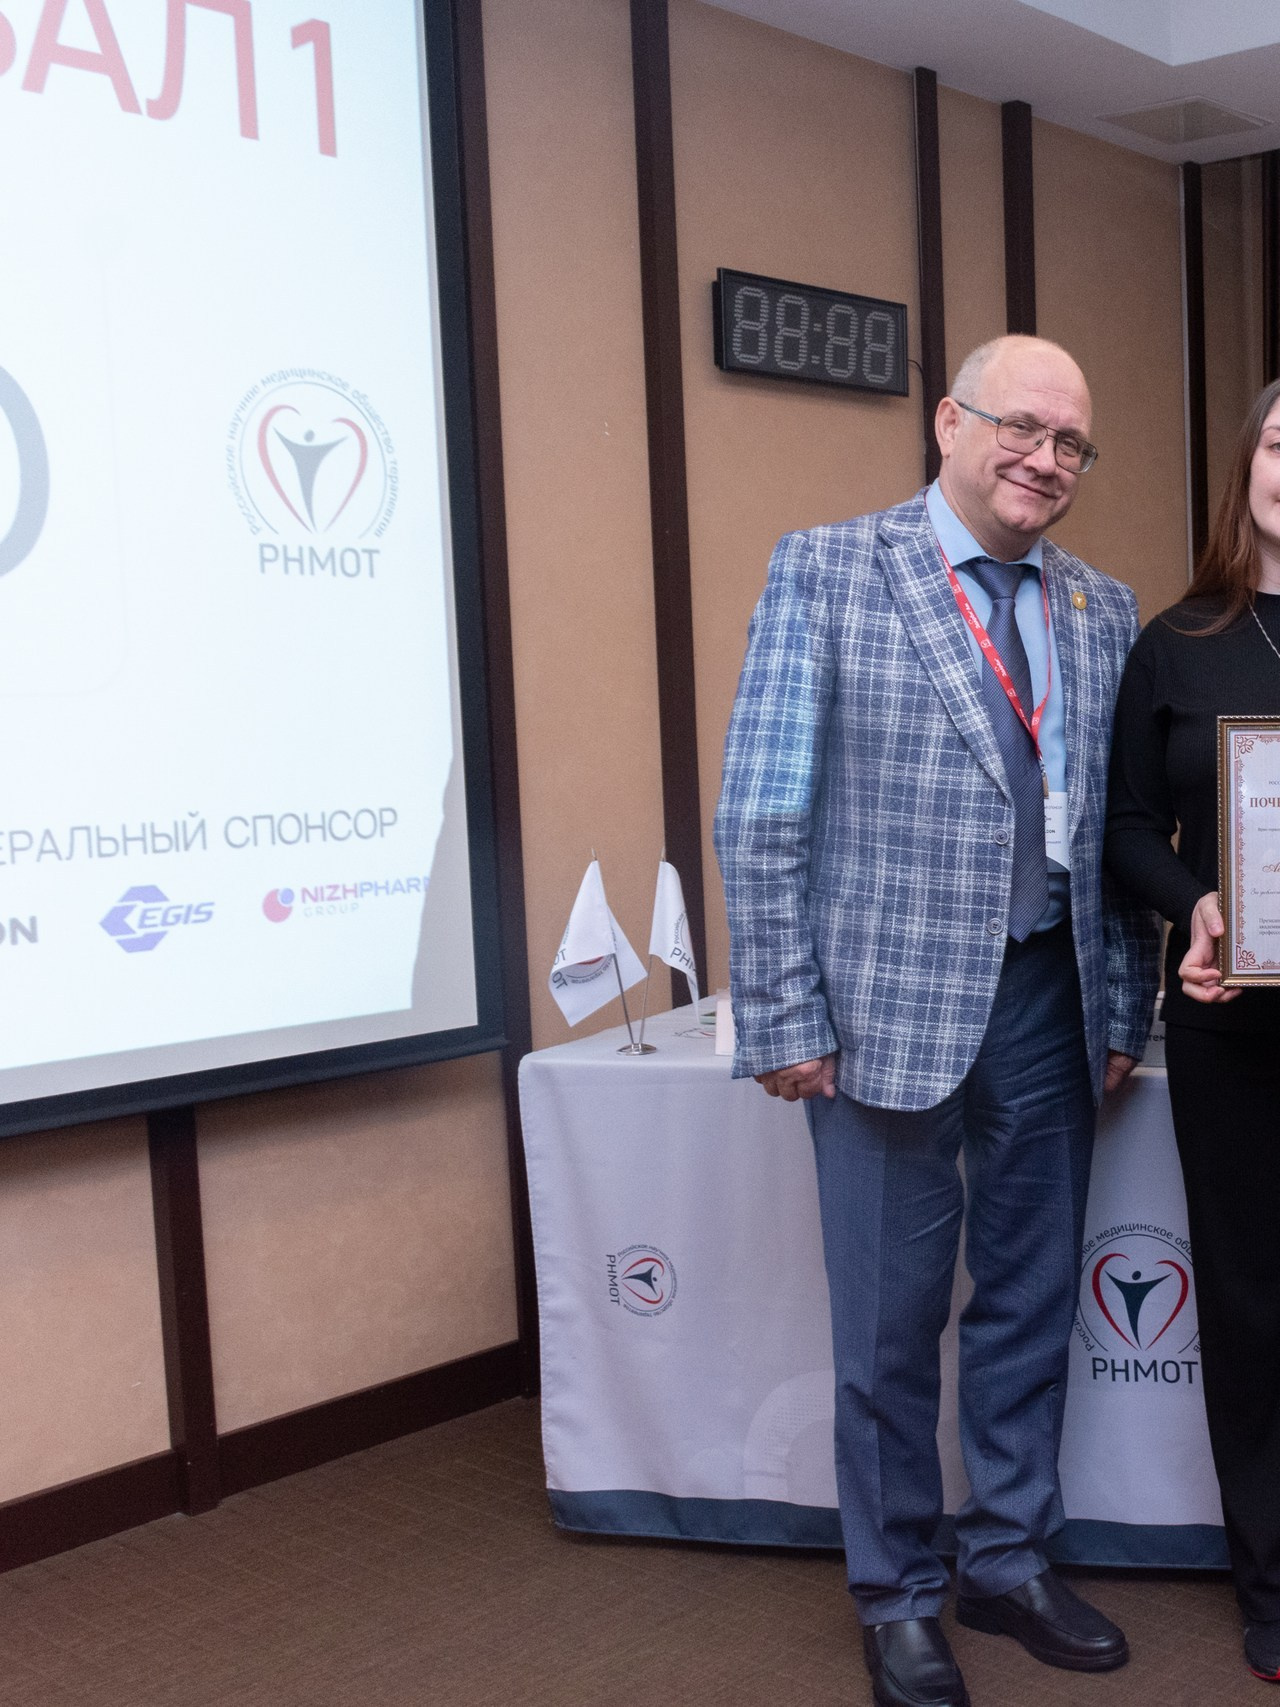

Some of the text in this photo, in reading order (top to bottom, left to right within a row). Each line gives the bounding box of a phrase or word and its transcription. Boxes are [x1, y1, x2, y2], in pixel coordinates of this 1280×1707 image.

[0, 0, 338, 159] АЛ 1
[257, 542, 381, 580] РНМОТ
[0, 806, 399, 866] РАЛЬНЫЙ СПОНСОР
[137, 900, 217, 931] EGIS
[303, 903, 360, 919] GROUP
[1095, 1223, 1174, 1242] медицинское
[606, 1254, 621, 1306] РНМОТ
[1091, 1357, 1199, 1385] РНМОТ
